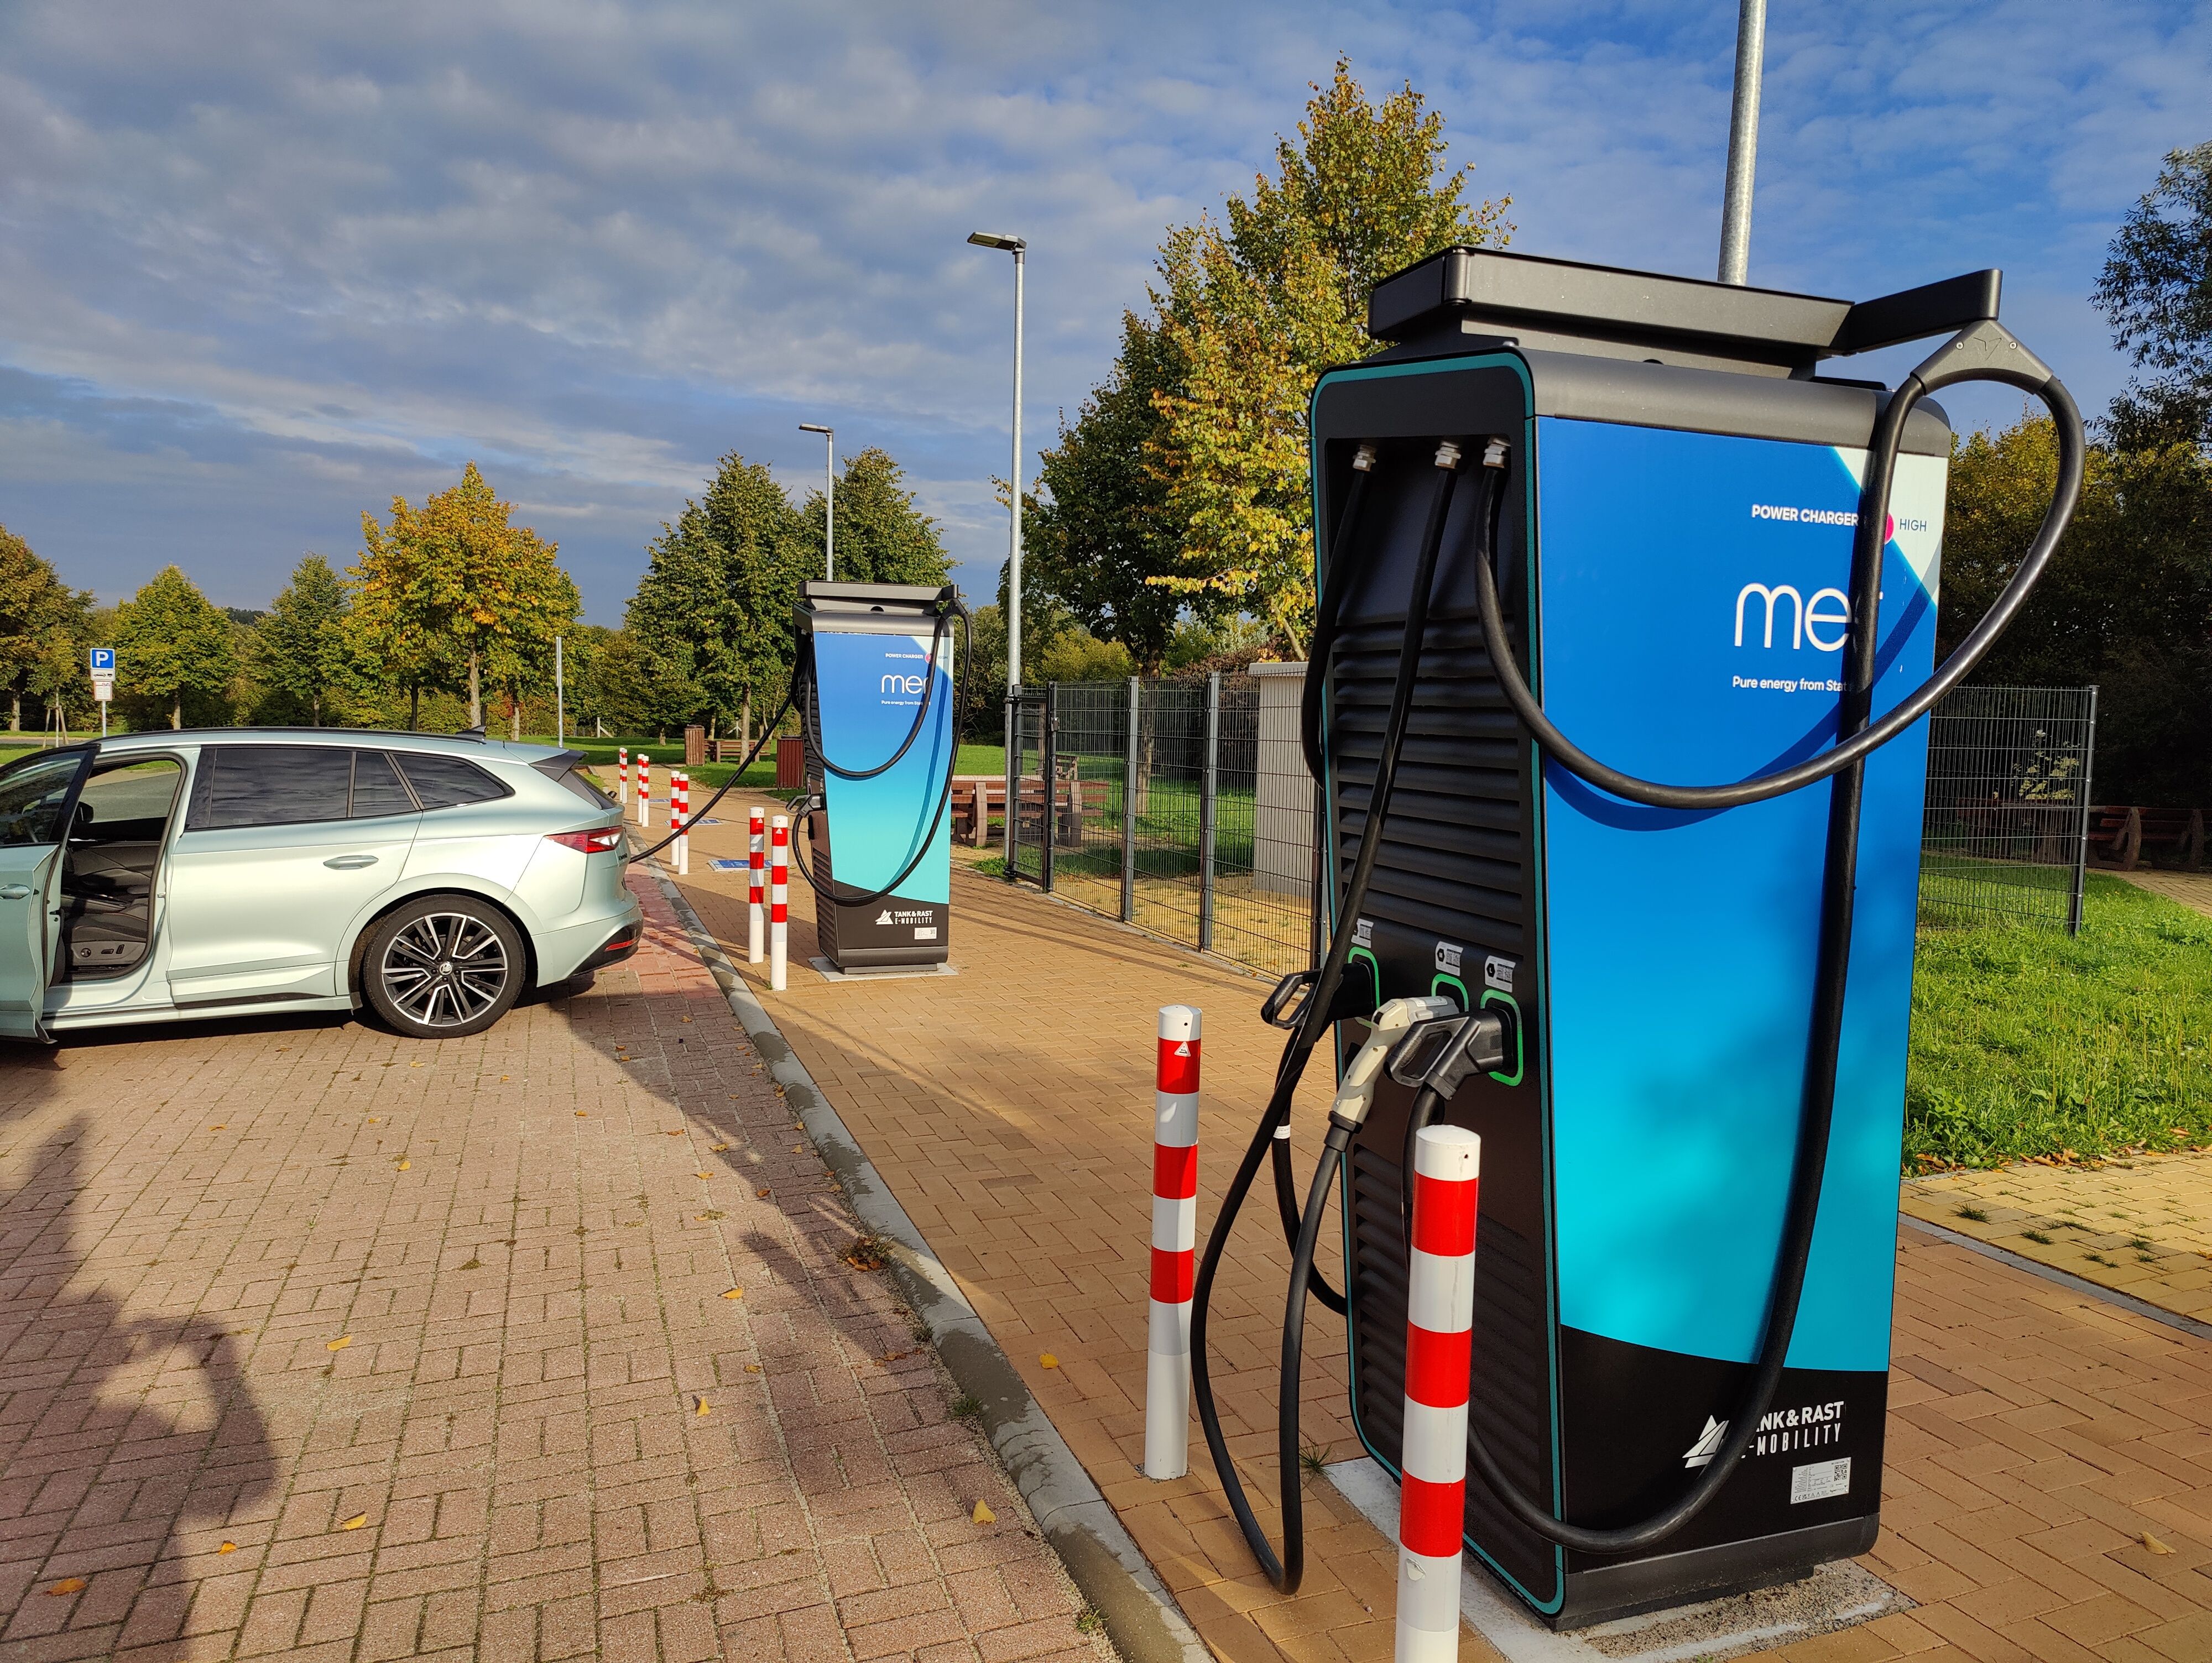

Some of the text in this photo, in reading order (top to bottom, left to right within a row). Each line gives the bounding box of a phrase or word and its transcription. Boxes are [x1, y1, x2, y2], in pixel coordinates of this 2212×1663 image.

[1751, 504, 1859, 526] POWER CHARGER
[1899, 518, 1927, 532] HIGH
[1734, 582, 1884, 651] me
[96, 651, 109, 667] P
[1733, 676, 1758, 688] Pure
[1760, 679, 1797, 692] energy
[1799, 677, 1824, 691] from
[1756, 1400, 1844, 1432] NK&RAST
[1741, 1423, 1841, 1458] -MOBILITY
